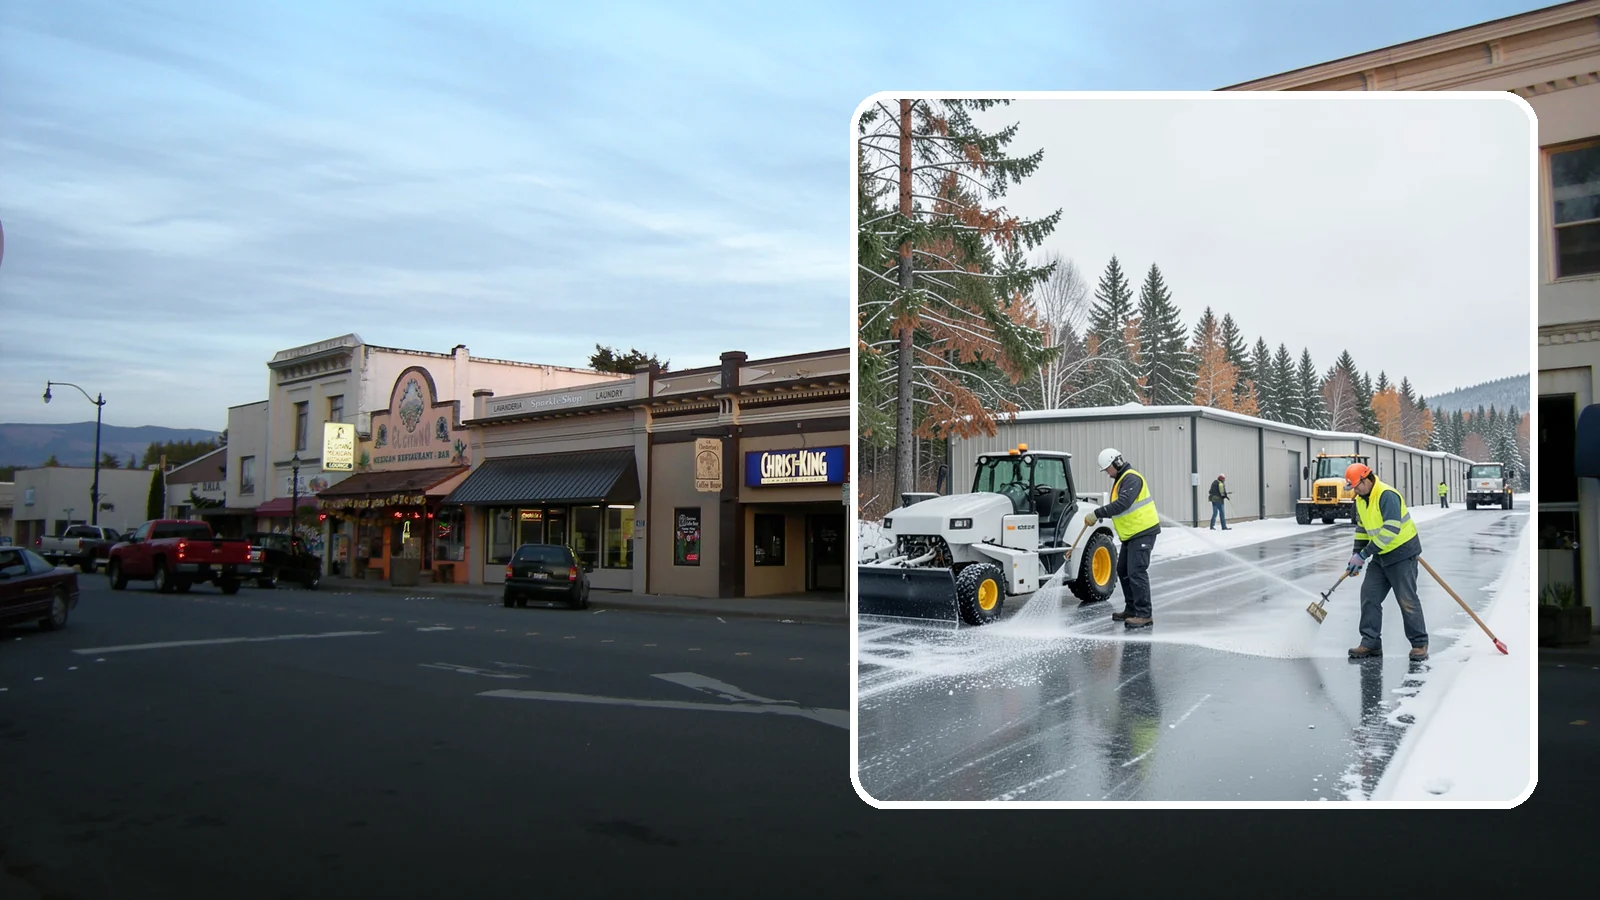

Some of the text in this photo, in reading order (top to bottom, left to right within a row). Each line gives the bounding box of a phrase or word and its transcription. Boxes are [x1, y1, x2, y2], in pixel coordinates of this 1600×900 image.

[562, 394, 582, 406] Shop
[596, 389, 623, 399] LAUNDRY
[493, 402, 522, 412] LAVANDERIA
[373, 455, 396, 464] MEXICAN
[397, 451, 433, 463] RESTAURANT
[437, 450, 450, 459] BAR
[761, 450, 827, 478] CHRIST KING
